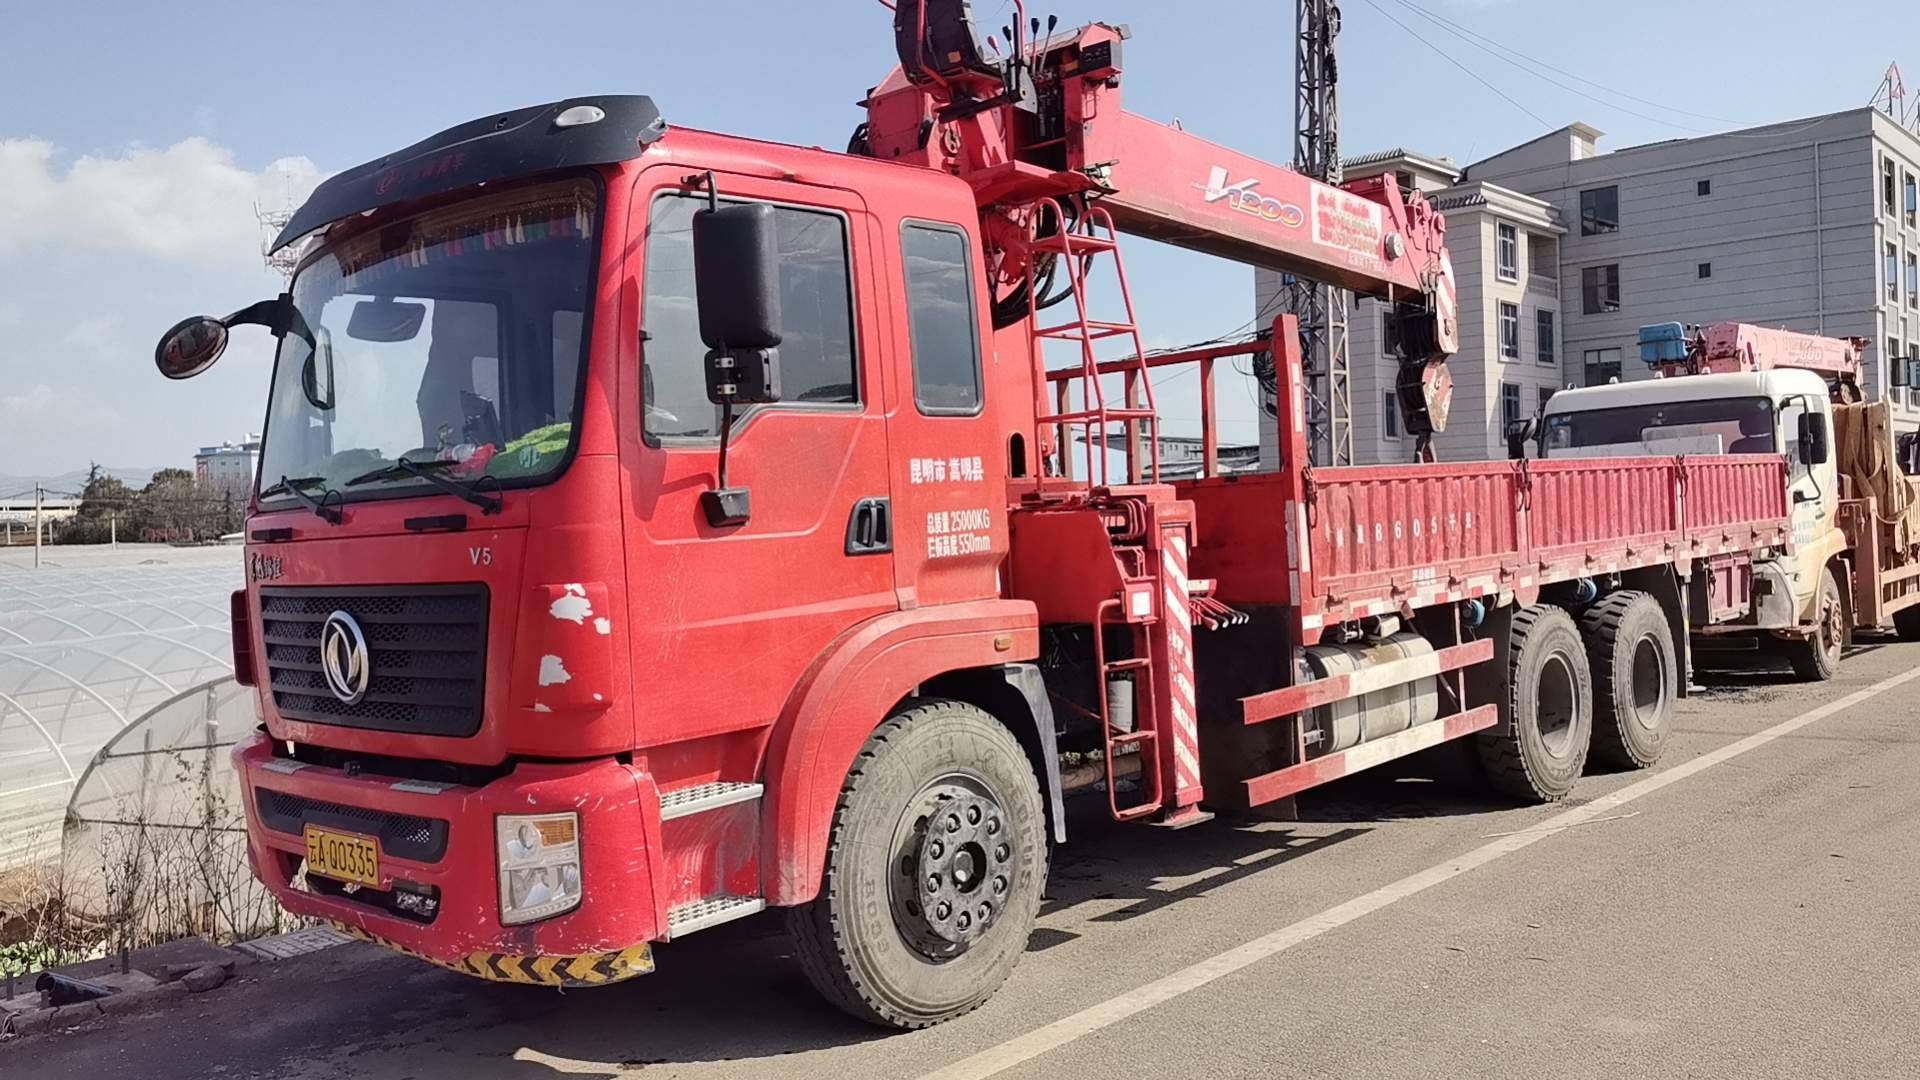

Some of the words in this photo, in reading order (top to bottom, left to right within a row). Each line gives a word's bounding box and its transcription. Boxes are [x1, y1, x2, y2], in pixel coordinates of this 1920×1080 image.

[910, 457, 946, 484] 昆明市
[927, 511, 950, 534] 总质量
[950, 508, 990, 532] 25000KG
[958, 532, 991, 555] 550mm
[469, 547, 492, 566] V5
